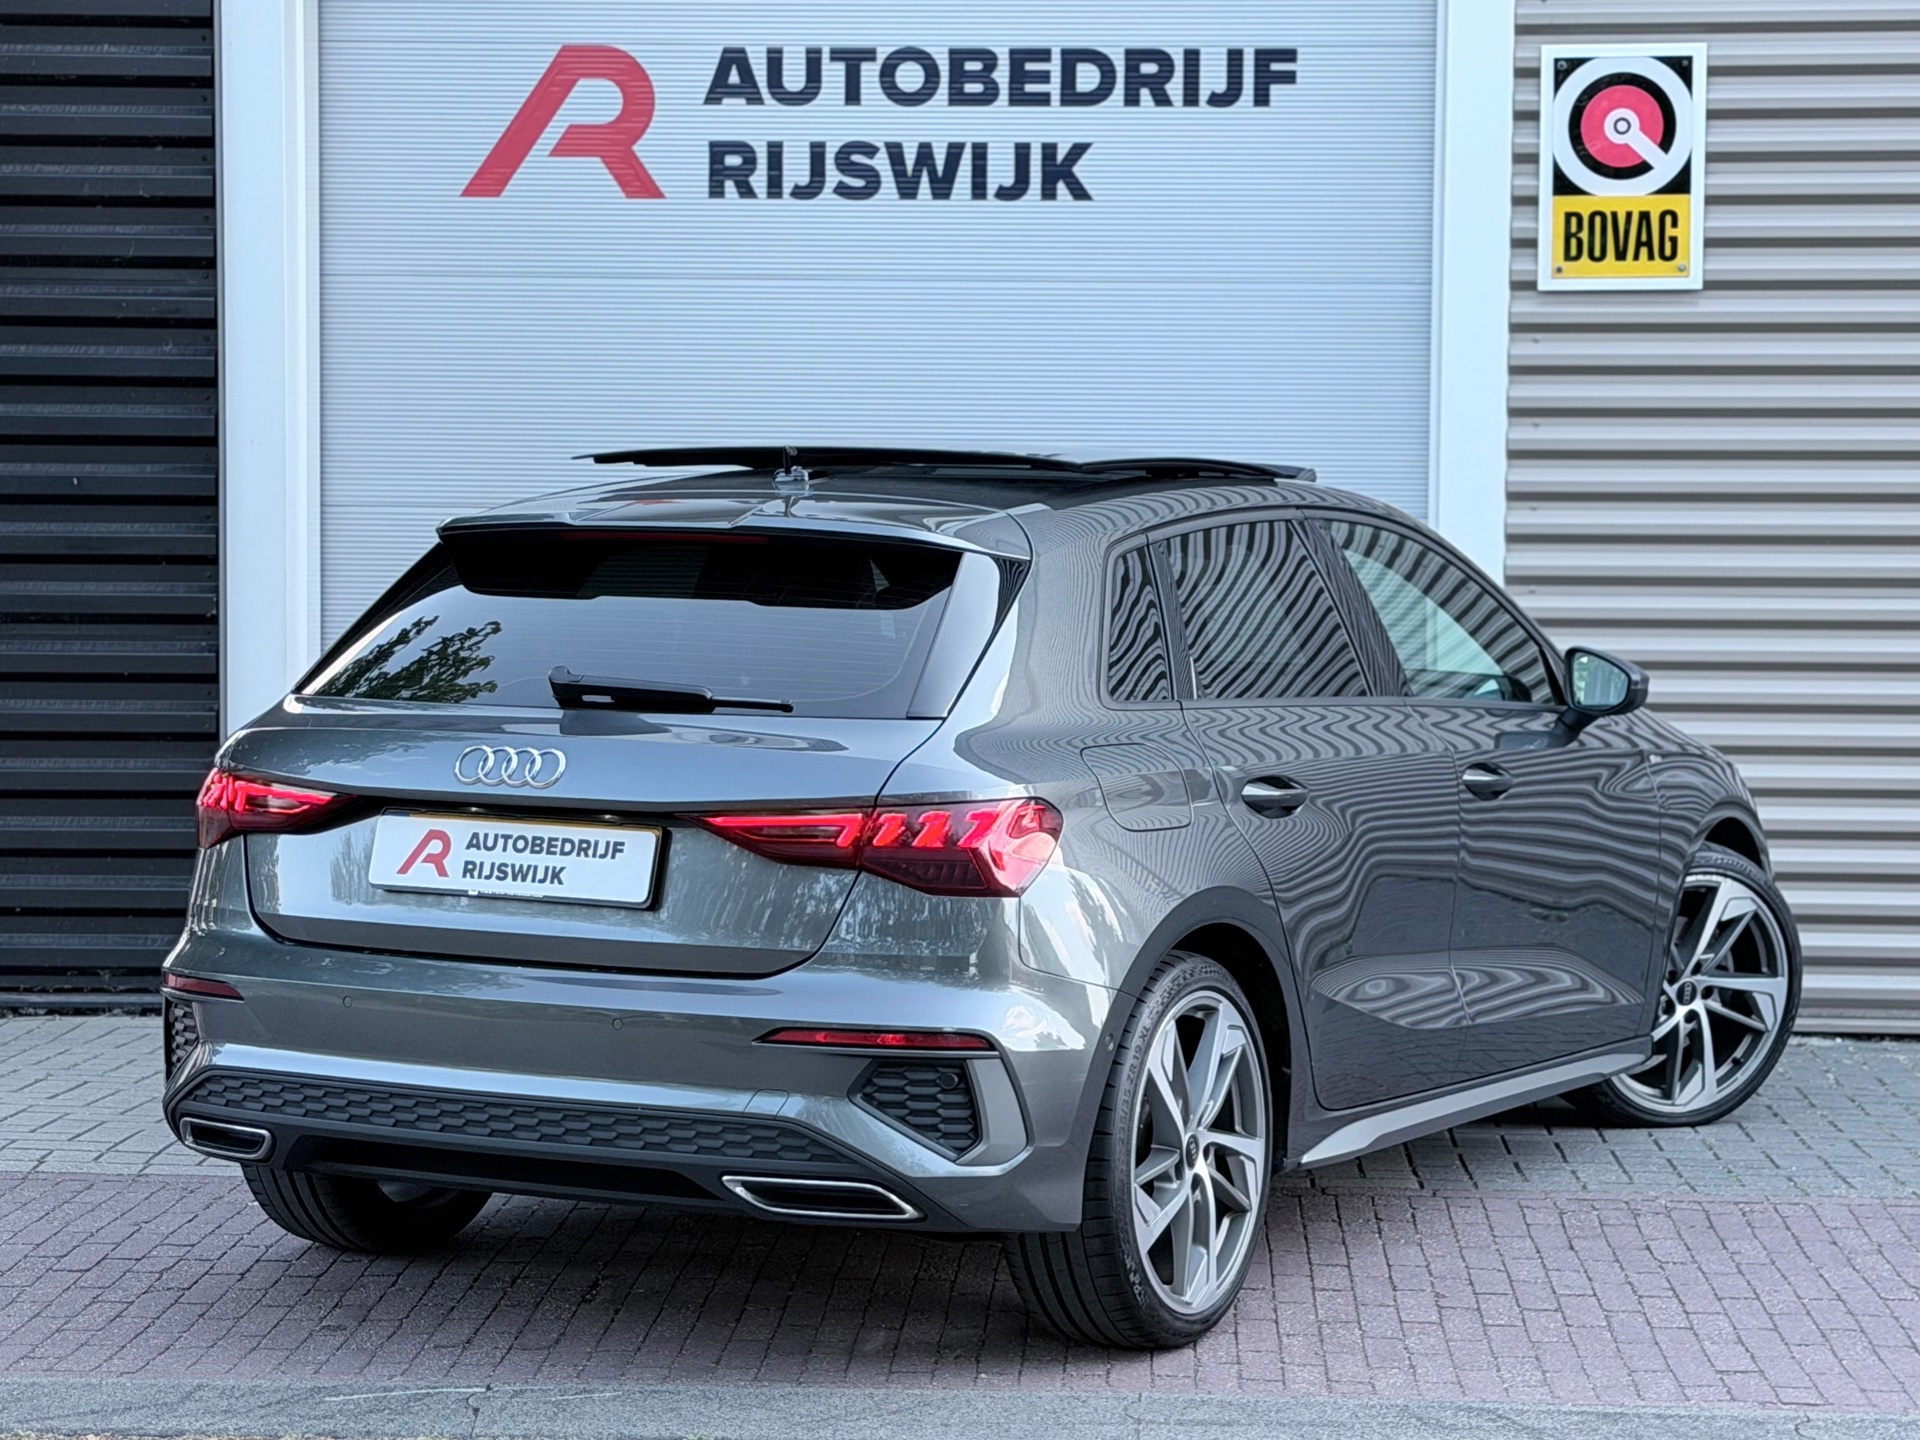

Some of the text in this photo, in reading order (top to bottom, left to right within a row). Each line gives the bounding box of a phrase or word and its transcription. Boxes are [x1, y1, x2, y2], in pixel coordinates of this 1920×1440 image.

[703, 46, 1299, 107] AUTOBEDRIJF
[708, 140, 1095, 201] RIJSWIJK
[1563, 209, 1679, 263] BOVAG
[465, 831, 626, 860] AUTOBEDRIJF
[461, 860, 566, 885] RIJSWIJK
[1138, 1025, 1151, 1042] XL
